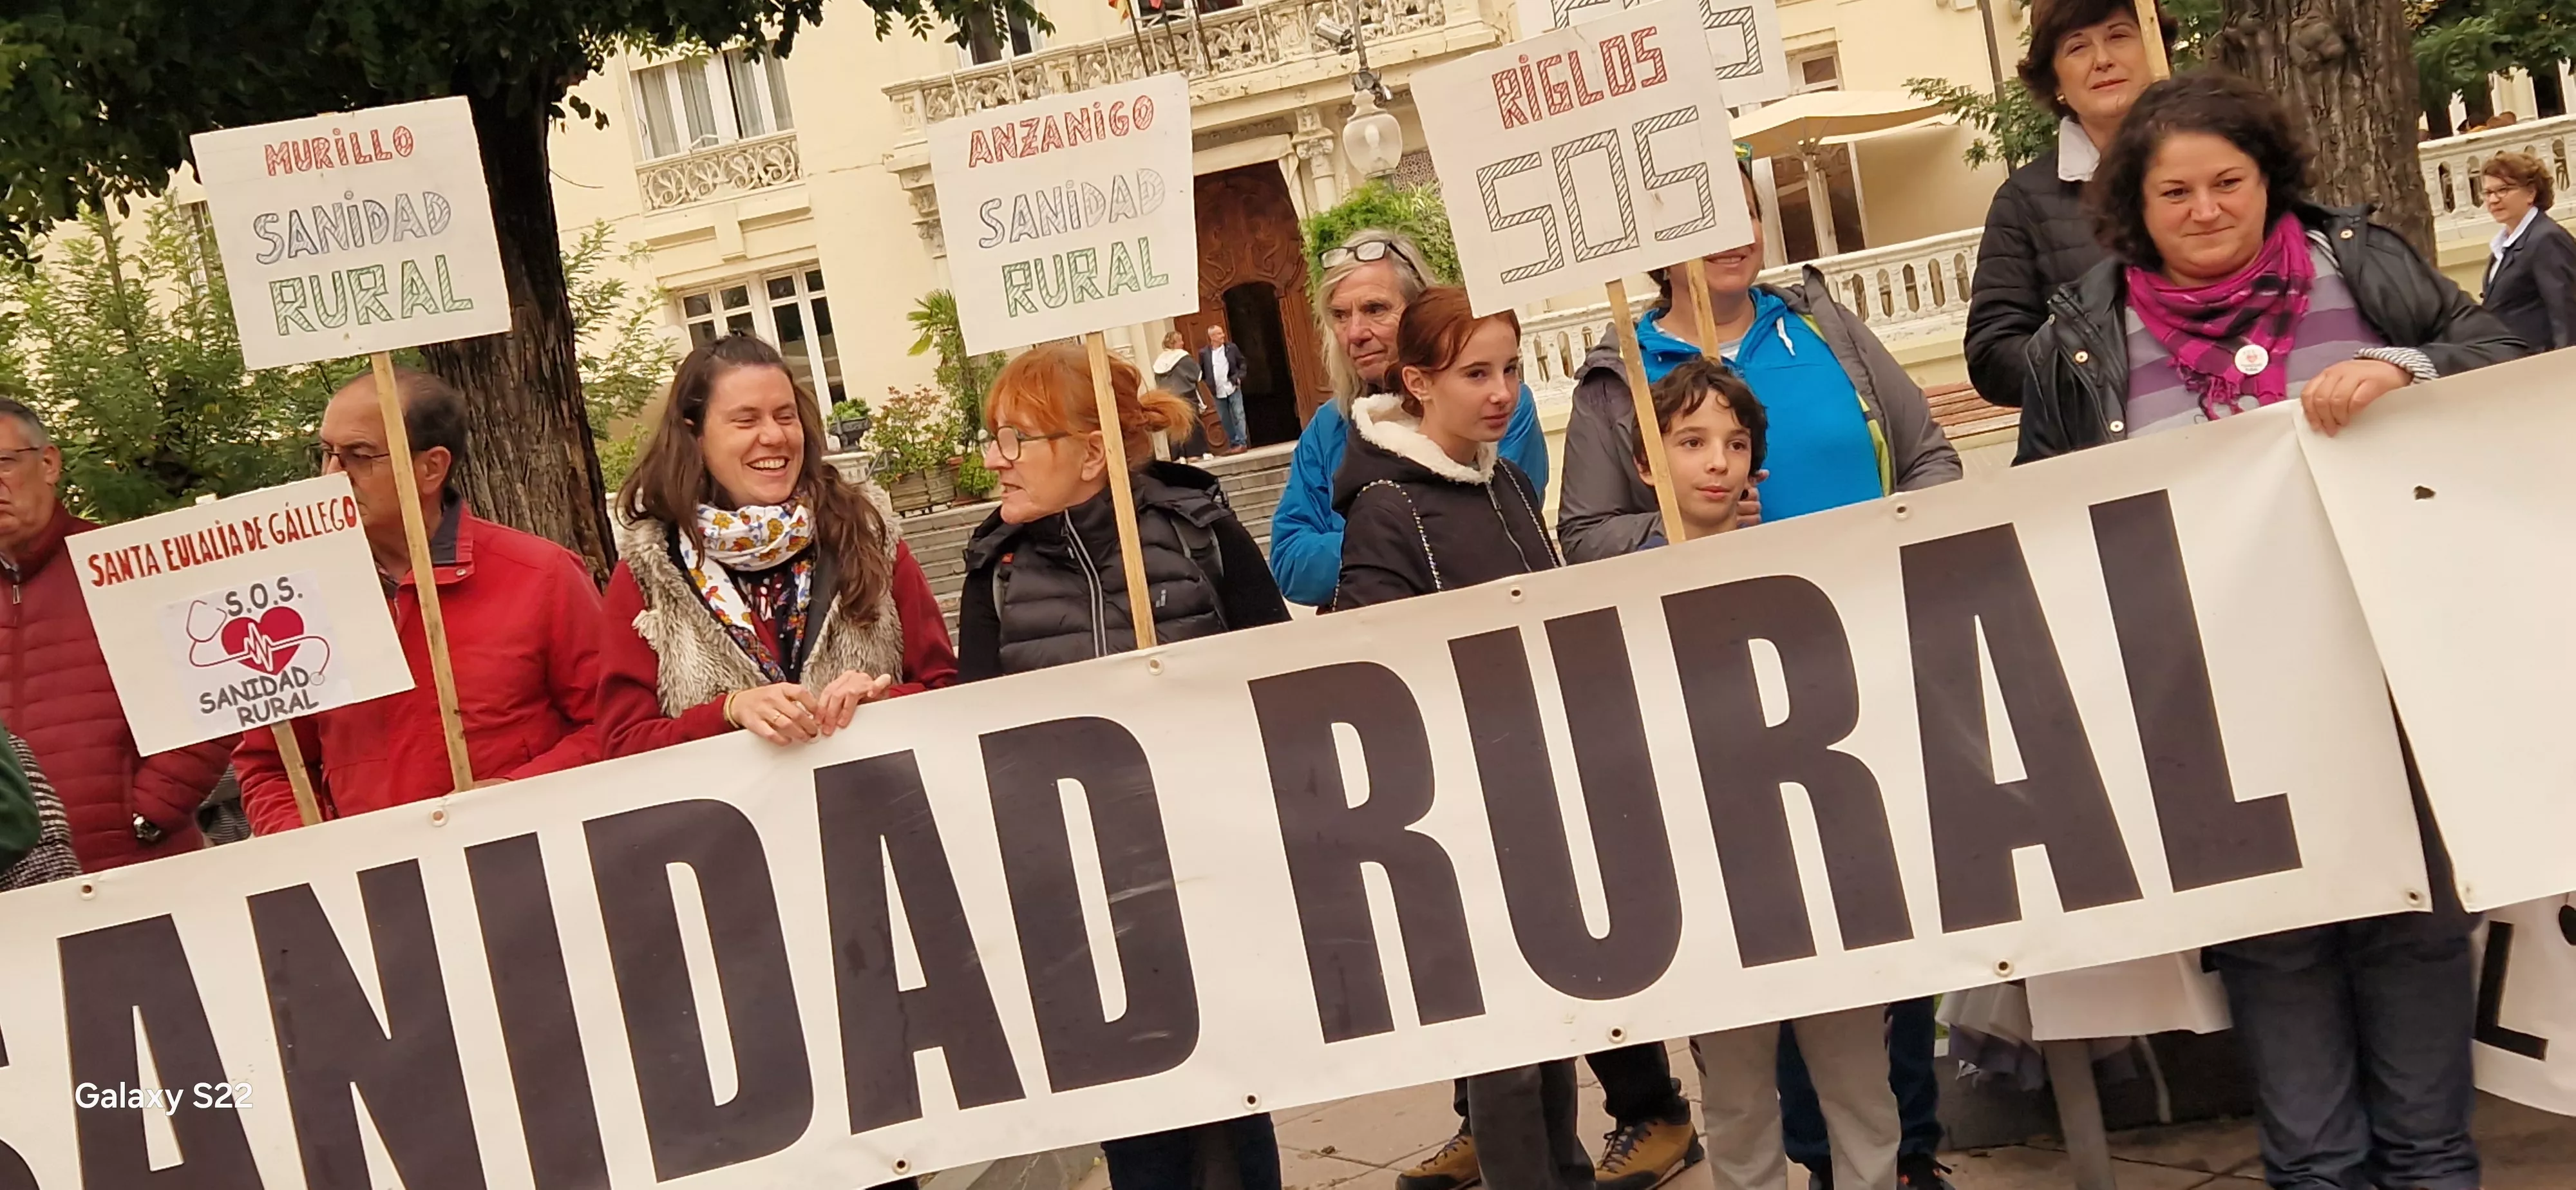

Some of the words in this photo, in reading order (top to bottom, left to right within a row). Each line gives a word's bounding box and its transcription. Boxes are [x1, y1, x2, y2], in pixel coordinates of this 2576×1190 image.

[1476, 105, 1716, 285] SOS
[269, 254, 474, 336] RURAL
[1001, 236, 1169, 318] RURAL
[88, 543, 162, 587] SANTA
[243, 515, 268, 552] DE
[268, 495, 358, 545] GÁLLEGO
[225, 576, 303, 617] S.O.S.
[199, 665, 310, 714] SANIDAD
[236, 688, 320, 727] RURAL
[1247, 488, 2304, 1046] RURAL
